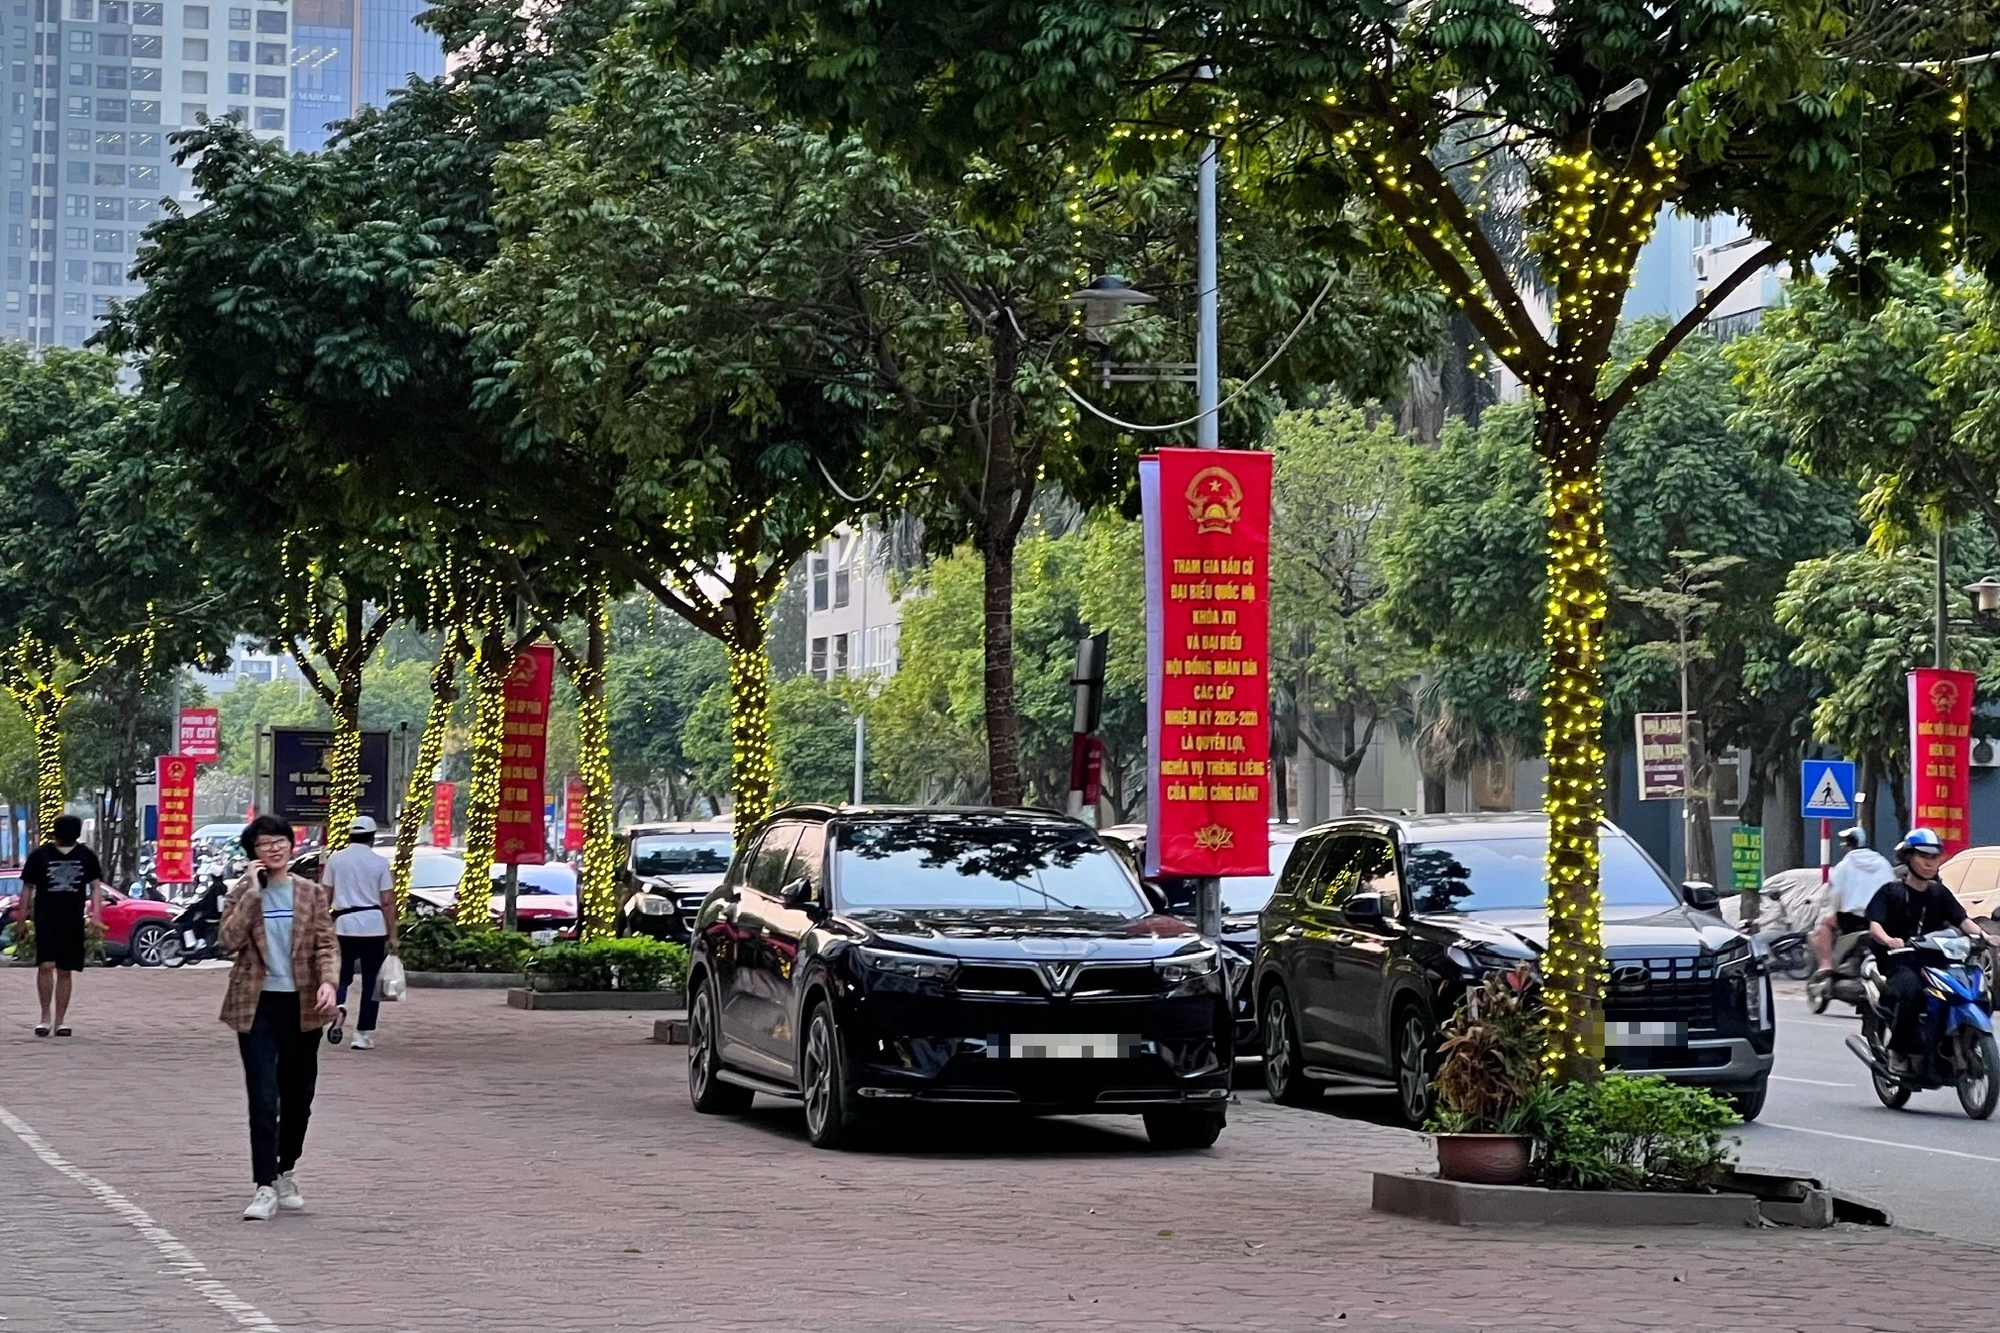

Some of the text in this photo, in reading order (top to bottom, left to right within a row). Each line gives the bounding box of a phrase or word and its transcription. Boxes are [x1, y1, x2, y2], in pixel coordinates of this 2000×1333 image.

[1173, 555, 1254, 575] THAM GIA BẦU CỬ
[1171, 579, 1256, 603] ĐẠI BIỂU QUỐC HỘI
[1221, 610, 1236, 624] XVI
[1186, 630, 1242, 653] VÀ ĐẠI BIỂU
[1165, 658, 1183, 678] HỘI
[1184, 655, 1212, 675] ĐỒNG
[1214, 658, 1240, 675] NHÂN
[1193, 681, 1234, 700] CÁC CẤP
[1165, 707, 1197, 728] NHIỆM
[1199, 708, 1212, 725] KỲ
[181, 727, 216, 739] FIT CITY
[1181, 733, 1194, 750] LÀ
[1196, 732, 1226, 751] QUYỀN
[1161, 758, 1265, 779] NGHĨA VỤ THIÊNG LIÊNG
[1167, 781, 1187, 800] CỦA
[1210, 782, 1233, 800] CÔNG
